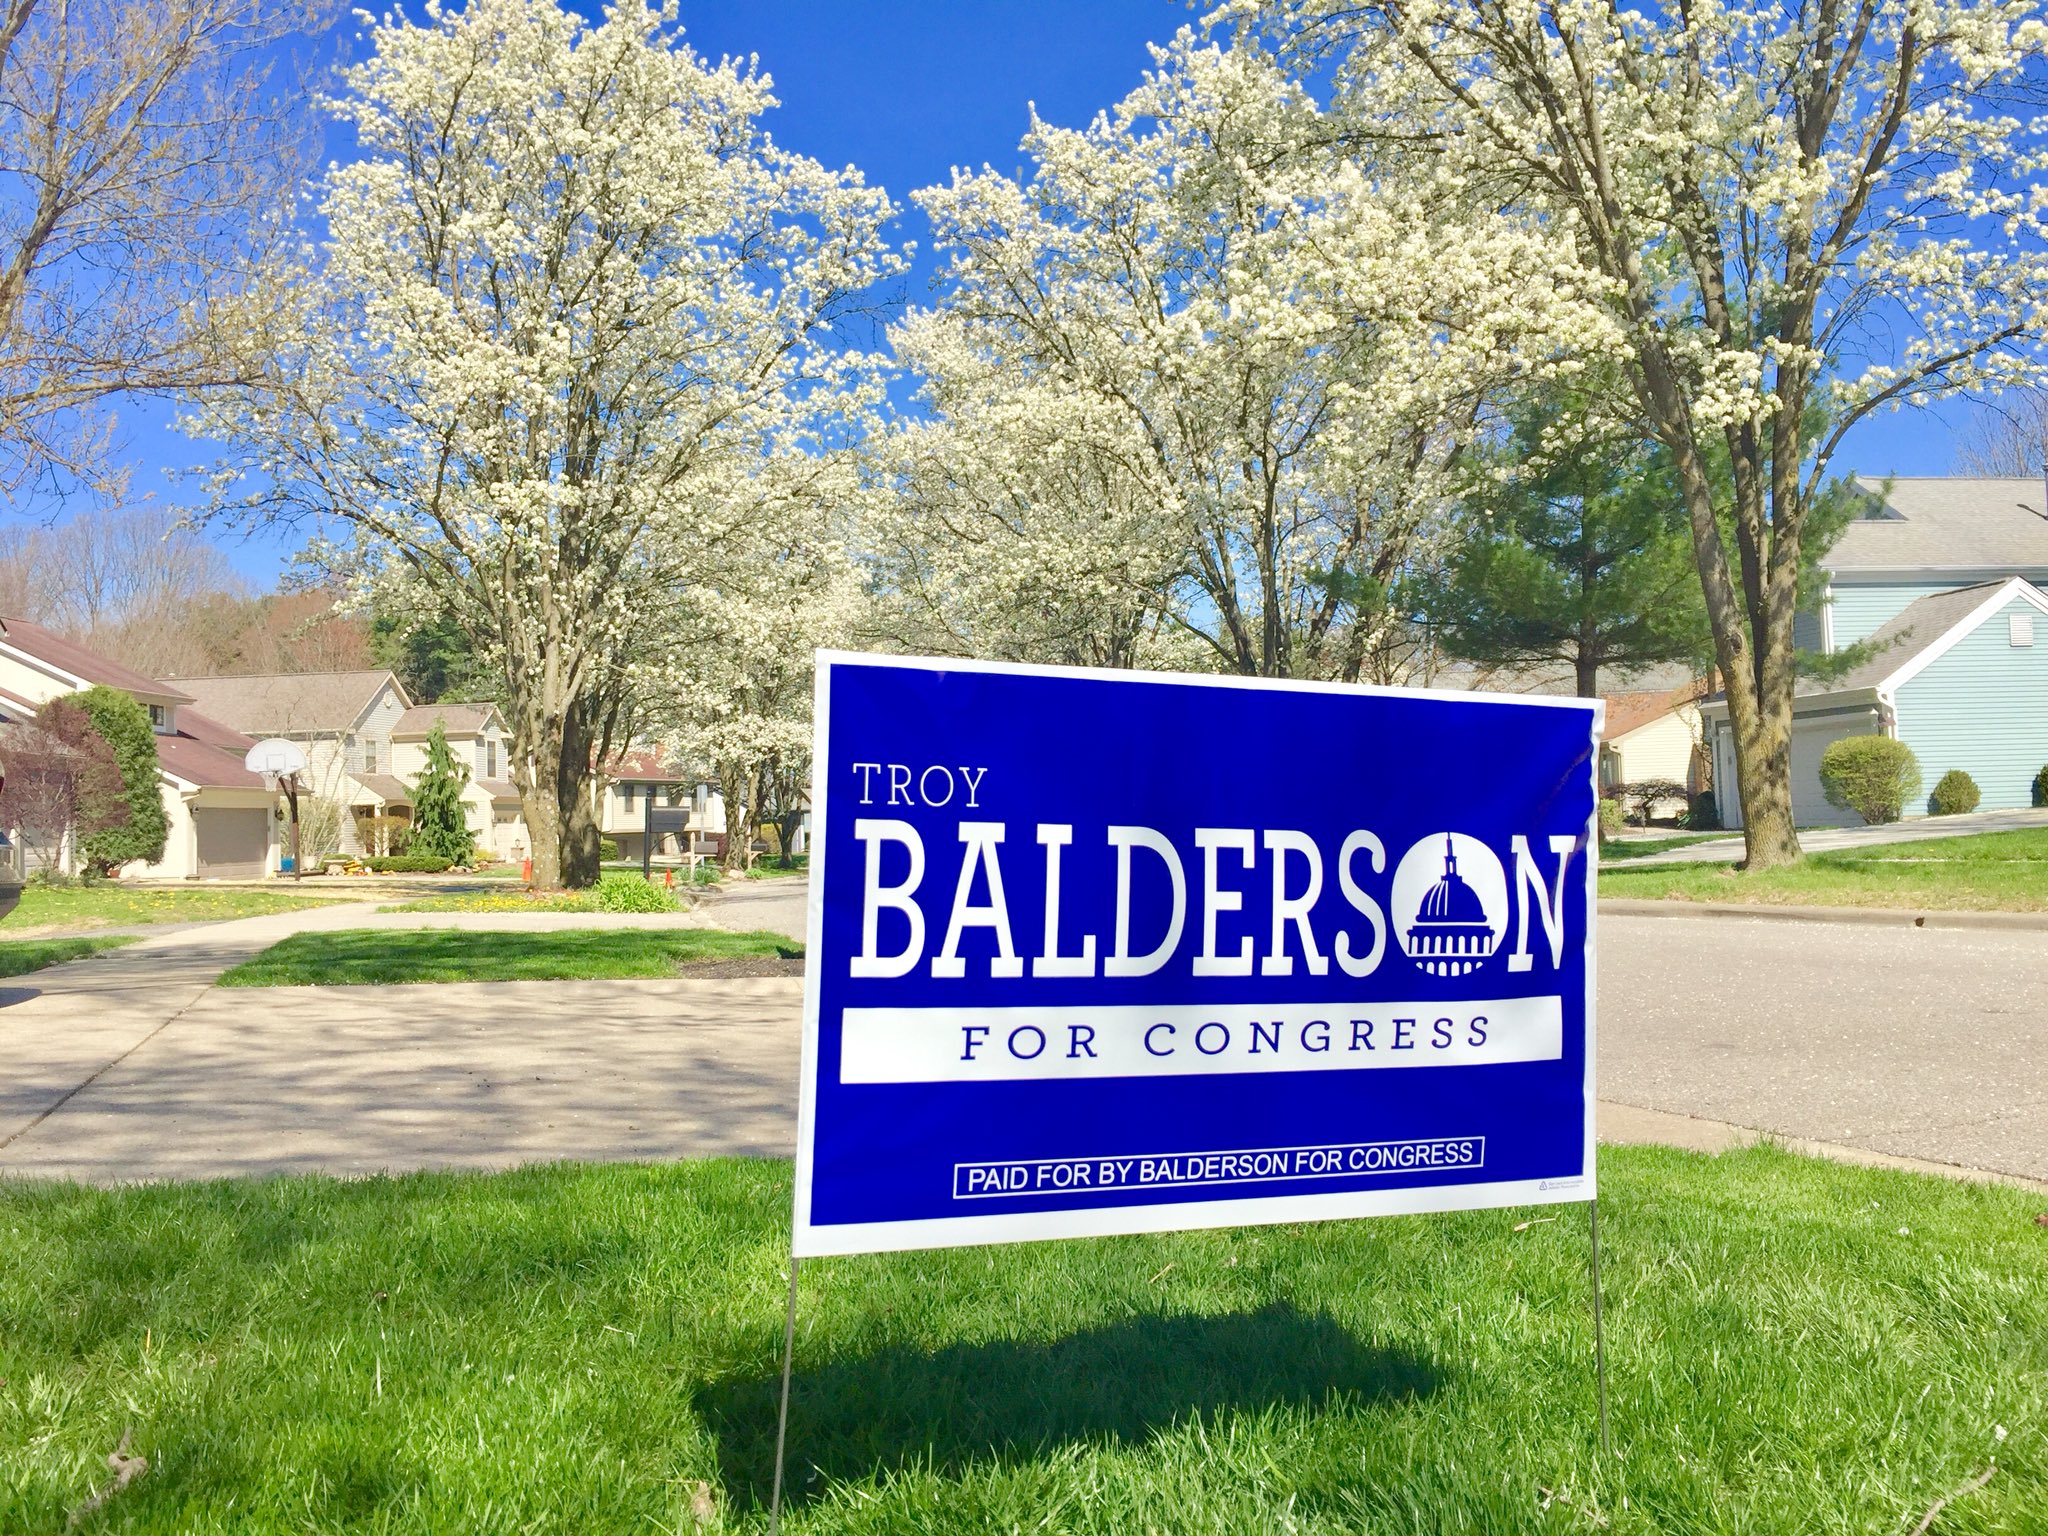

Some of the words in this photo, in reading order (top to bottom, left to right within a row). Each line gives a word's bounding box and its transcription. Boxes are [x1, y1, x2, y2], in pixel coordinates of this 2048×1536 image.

[853, 763, 987, 807] TROY
[850, 819, 1576, 979] BALDERSON
[961, 1025, 1097, 1060] FOR
[1144, 1017, 1488, 1056] CONGRESS
[969, 1167, 1028, 1191] PAID
[1036, 1164, 1090, 1188] FOR
[1098, 1161, 1133, 1185] BY
[1139, 1153, 1288, 1182] BALDERSON
[1296, 1150, 1342, 1173] FOR
[1349, 1142, 1473, 1170] CONGRESS
